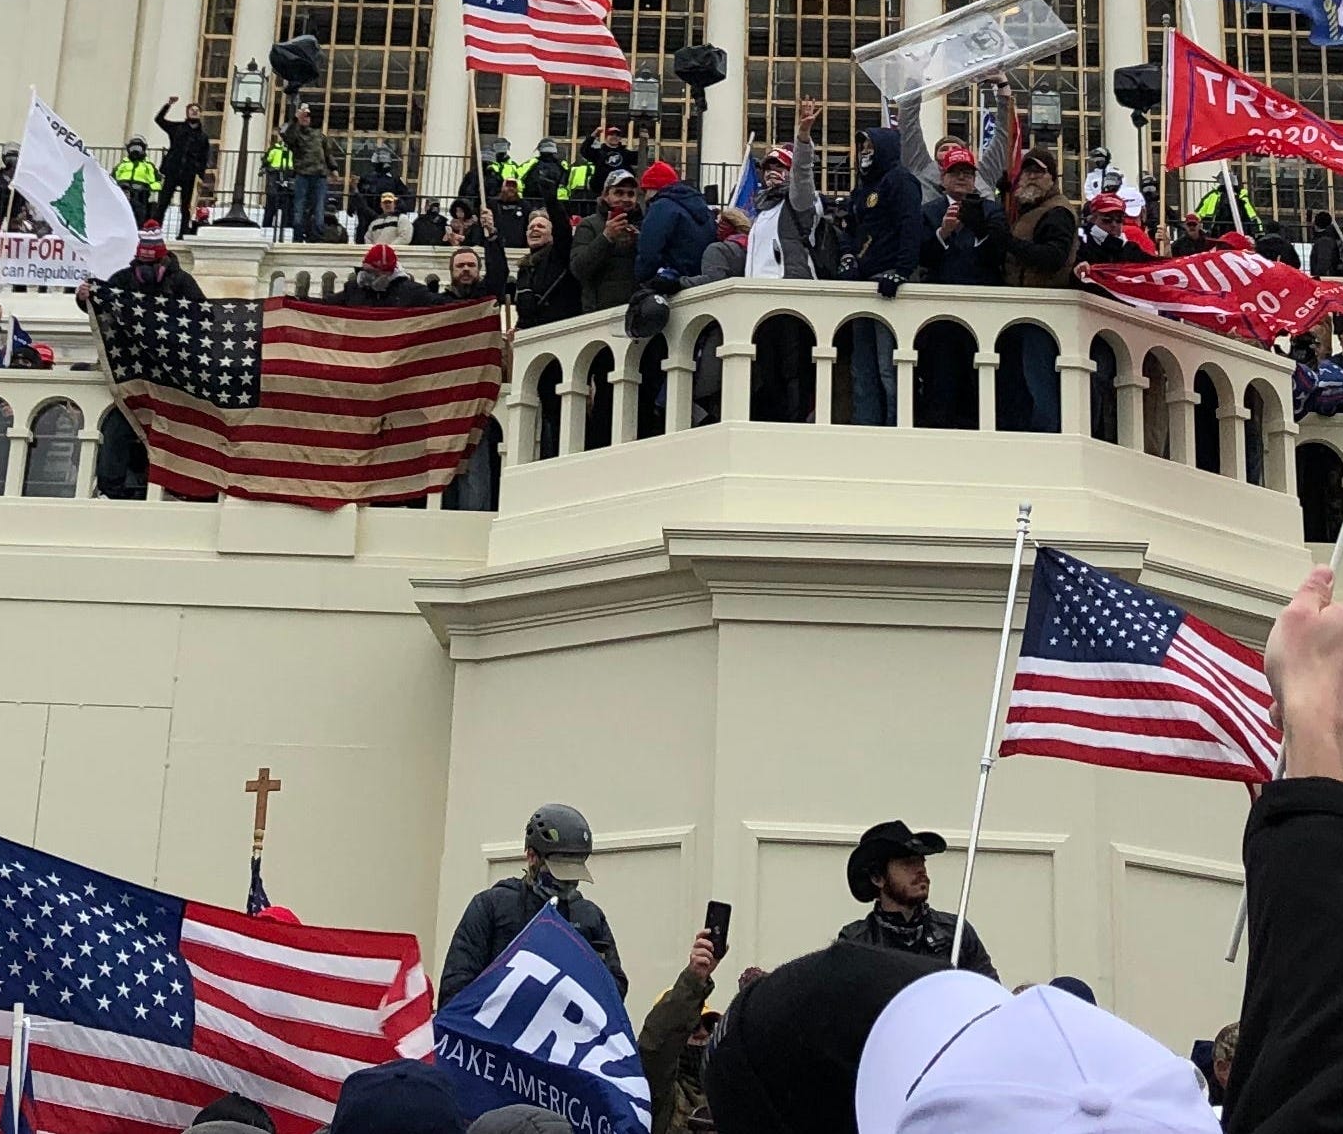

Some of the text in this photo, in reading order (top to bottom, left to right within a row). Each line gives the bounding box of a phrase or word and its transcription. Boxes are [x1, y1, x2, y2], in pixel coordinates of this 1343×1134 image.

[27, 238, 66, 261] FOR
[472, 949, 652, 1132] TRU
[500, 1062, 593, 1131] AMERICA
